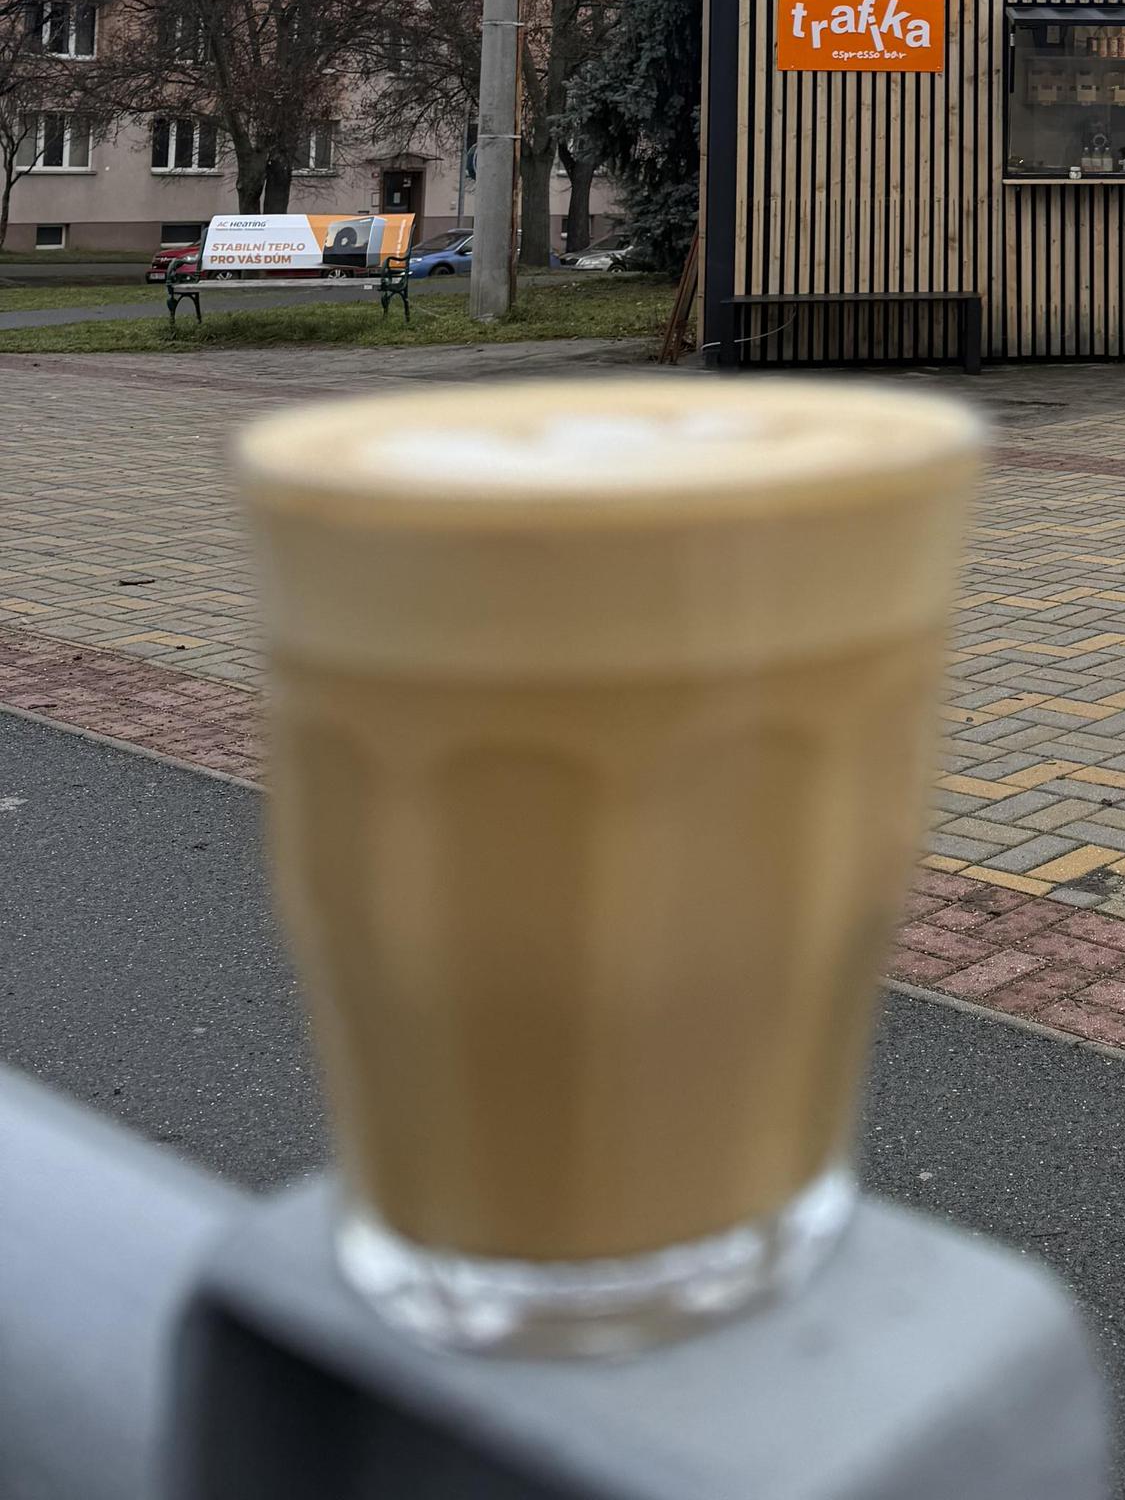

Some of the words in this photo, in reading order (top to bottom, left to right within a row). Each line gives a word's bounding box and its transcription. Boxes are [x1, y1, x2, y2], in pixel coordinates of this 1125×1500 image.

[832, 50, 880, 61] espresso
[883, 49, 907, 60] bar
[212, 241, 265, 251] STABILNÍ
[267, 243, 305, 251] TEPLO
[210, 255, 235, 264] PRO
[237, 253, 261, 264] VÁŠ
